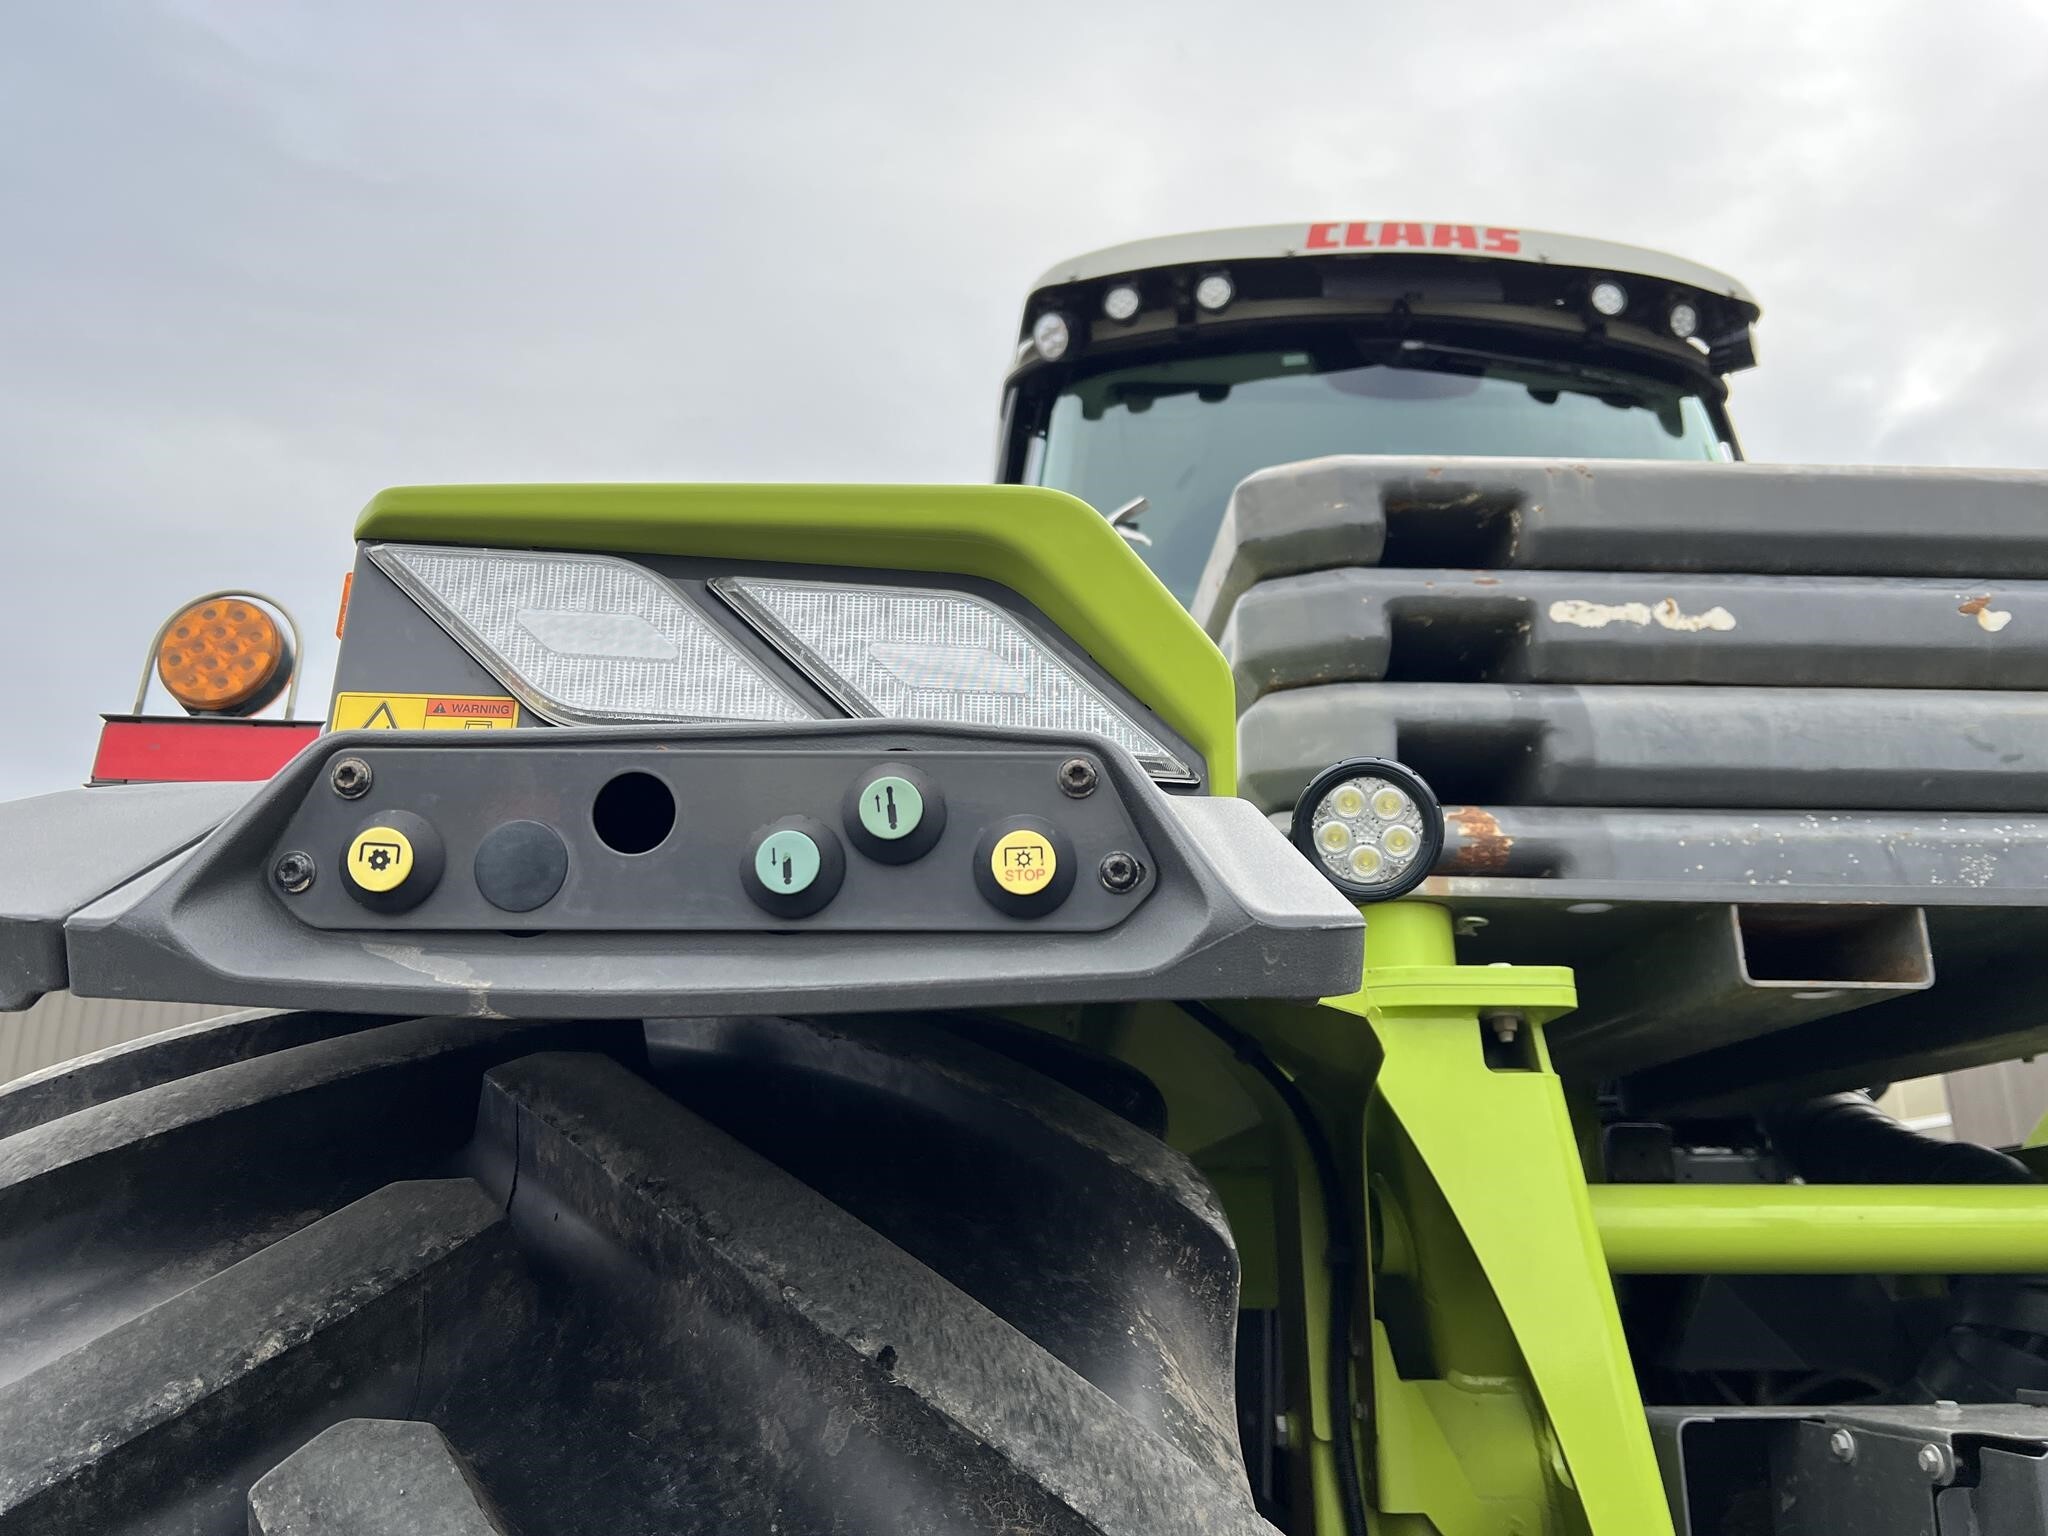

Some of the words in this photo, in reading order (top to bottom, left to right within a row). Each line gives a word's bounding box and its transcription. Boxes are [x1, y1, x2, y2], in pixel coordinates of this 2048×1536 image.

[1305, 222, 1521, 254] CLAAS
[452, 703, 510, 715] WARNING
[1005, 868, 1045, 882] STOP
